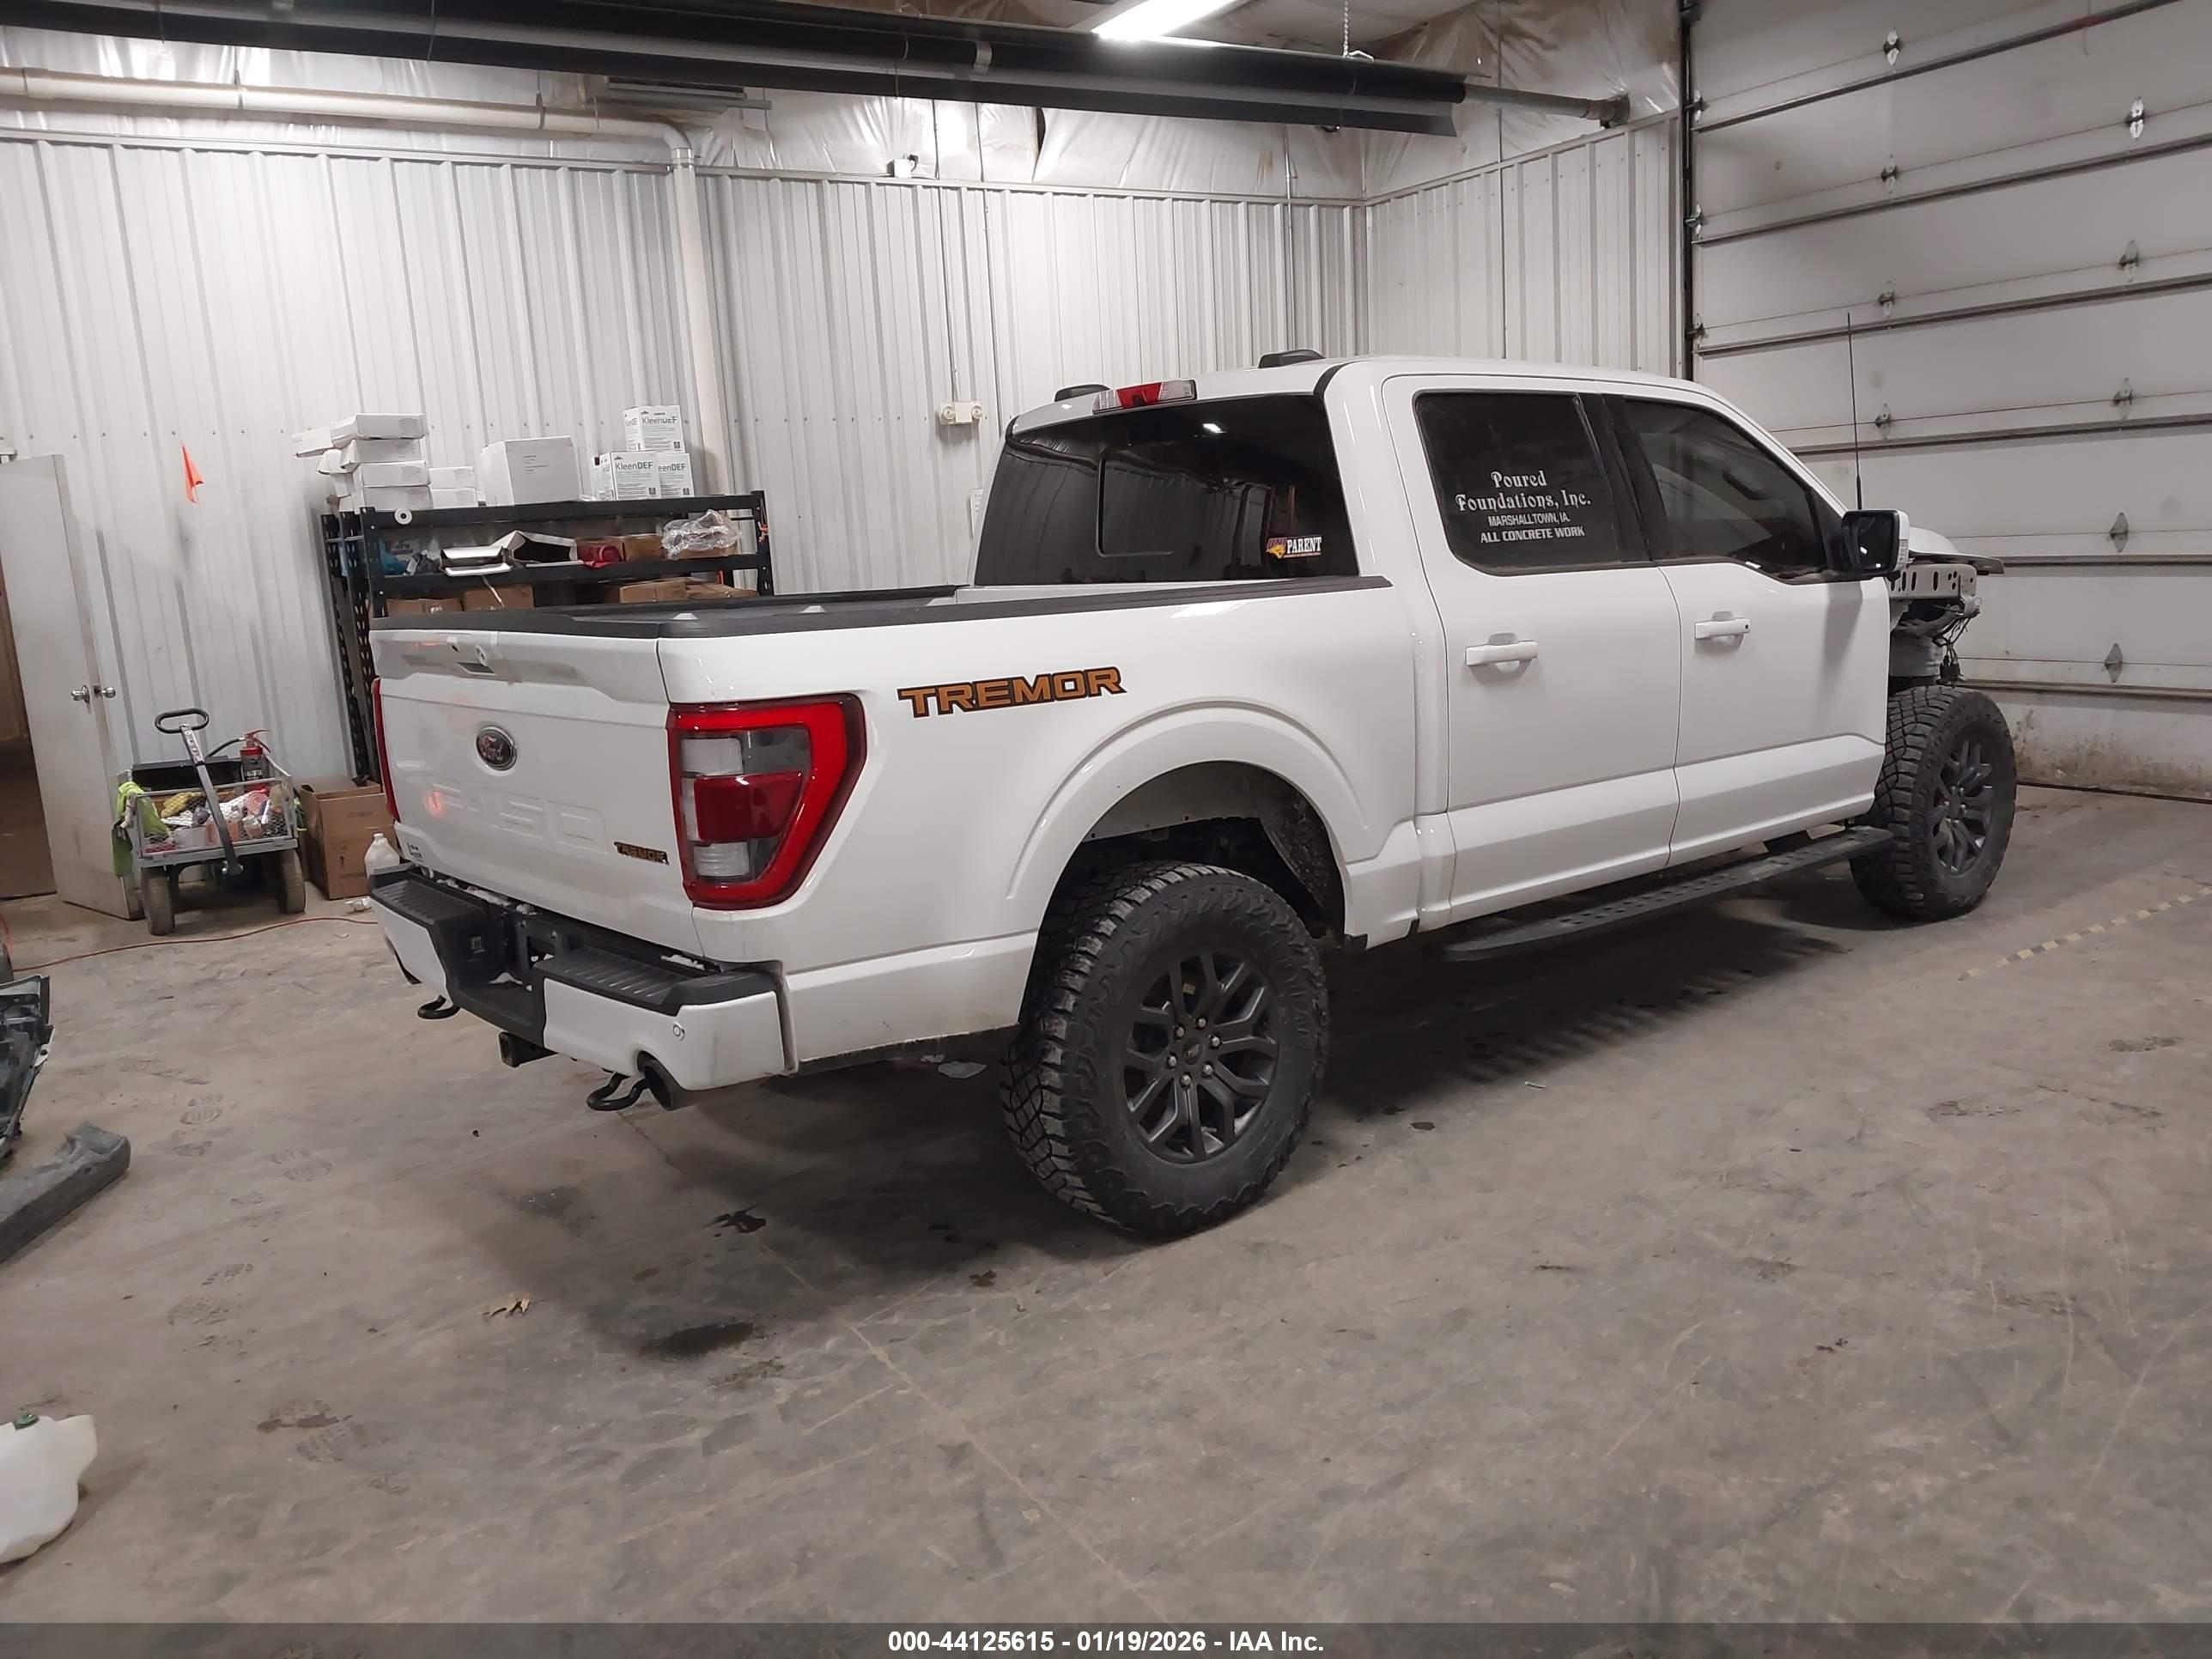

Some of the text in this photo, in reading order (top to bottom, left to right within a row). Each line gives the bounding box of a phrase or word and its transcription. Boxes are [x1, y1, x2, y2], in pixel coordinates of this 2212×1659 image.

[615, 461, 653, 471] KleenDEF
[659, 463, 687, 472] eenDEF
[1491, 470, 1547, 489] Poured
[1455, 489, 1591, 512] Foundations, Inc.
[1487, 512, 1559, 526] MARSHALLTOWN,
[1480, 526, 1585, 544] ALL CONCRETE WORK
[1286, 537, 1322, 554] PARENT
[897, 666, 1127, 718] TREMOR
[613, 842, 670, 866] TREMOR
